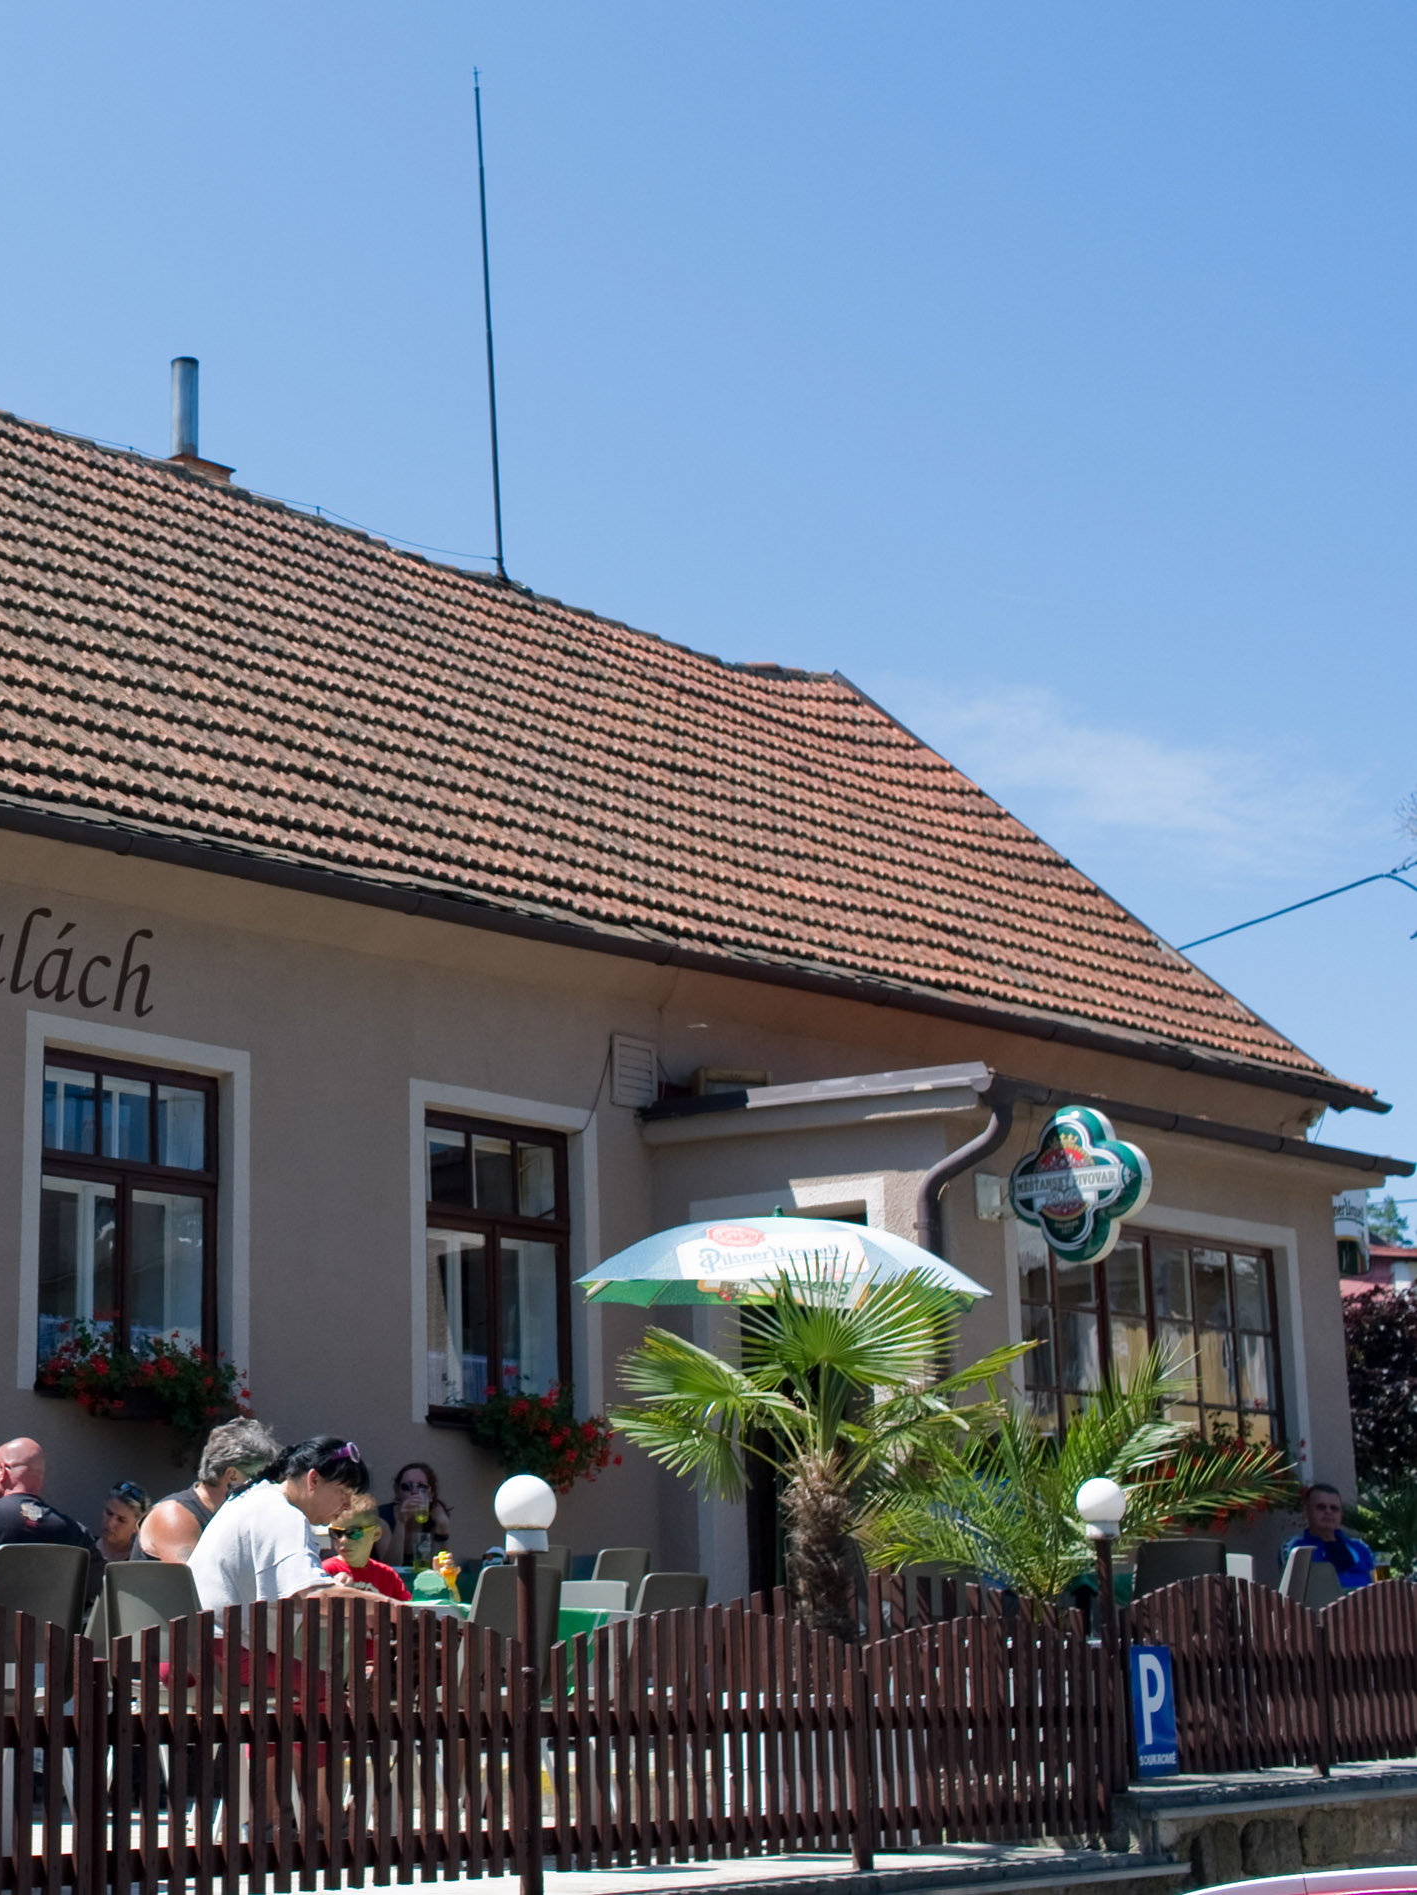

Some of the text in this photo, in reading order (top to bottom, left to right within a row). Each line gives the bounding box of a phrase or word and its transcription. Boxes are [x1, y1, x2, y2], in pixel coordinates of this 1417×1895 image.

[1073, 1170, 1116, 1187] PIVOVAR
[698, 1247, 768, 1274] Pilsner
[1138, 1653, 1165, 1746] P
